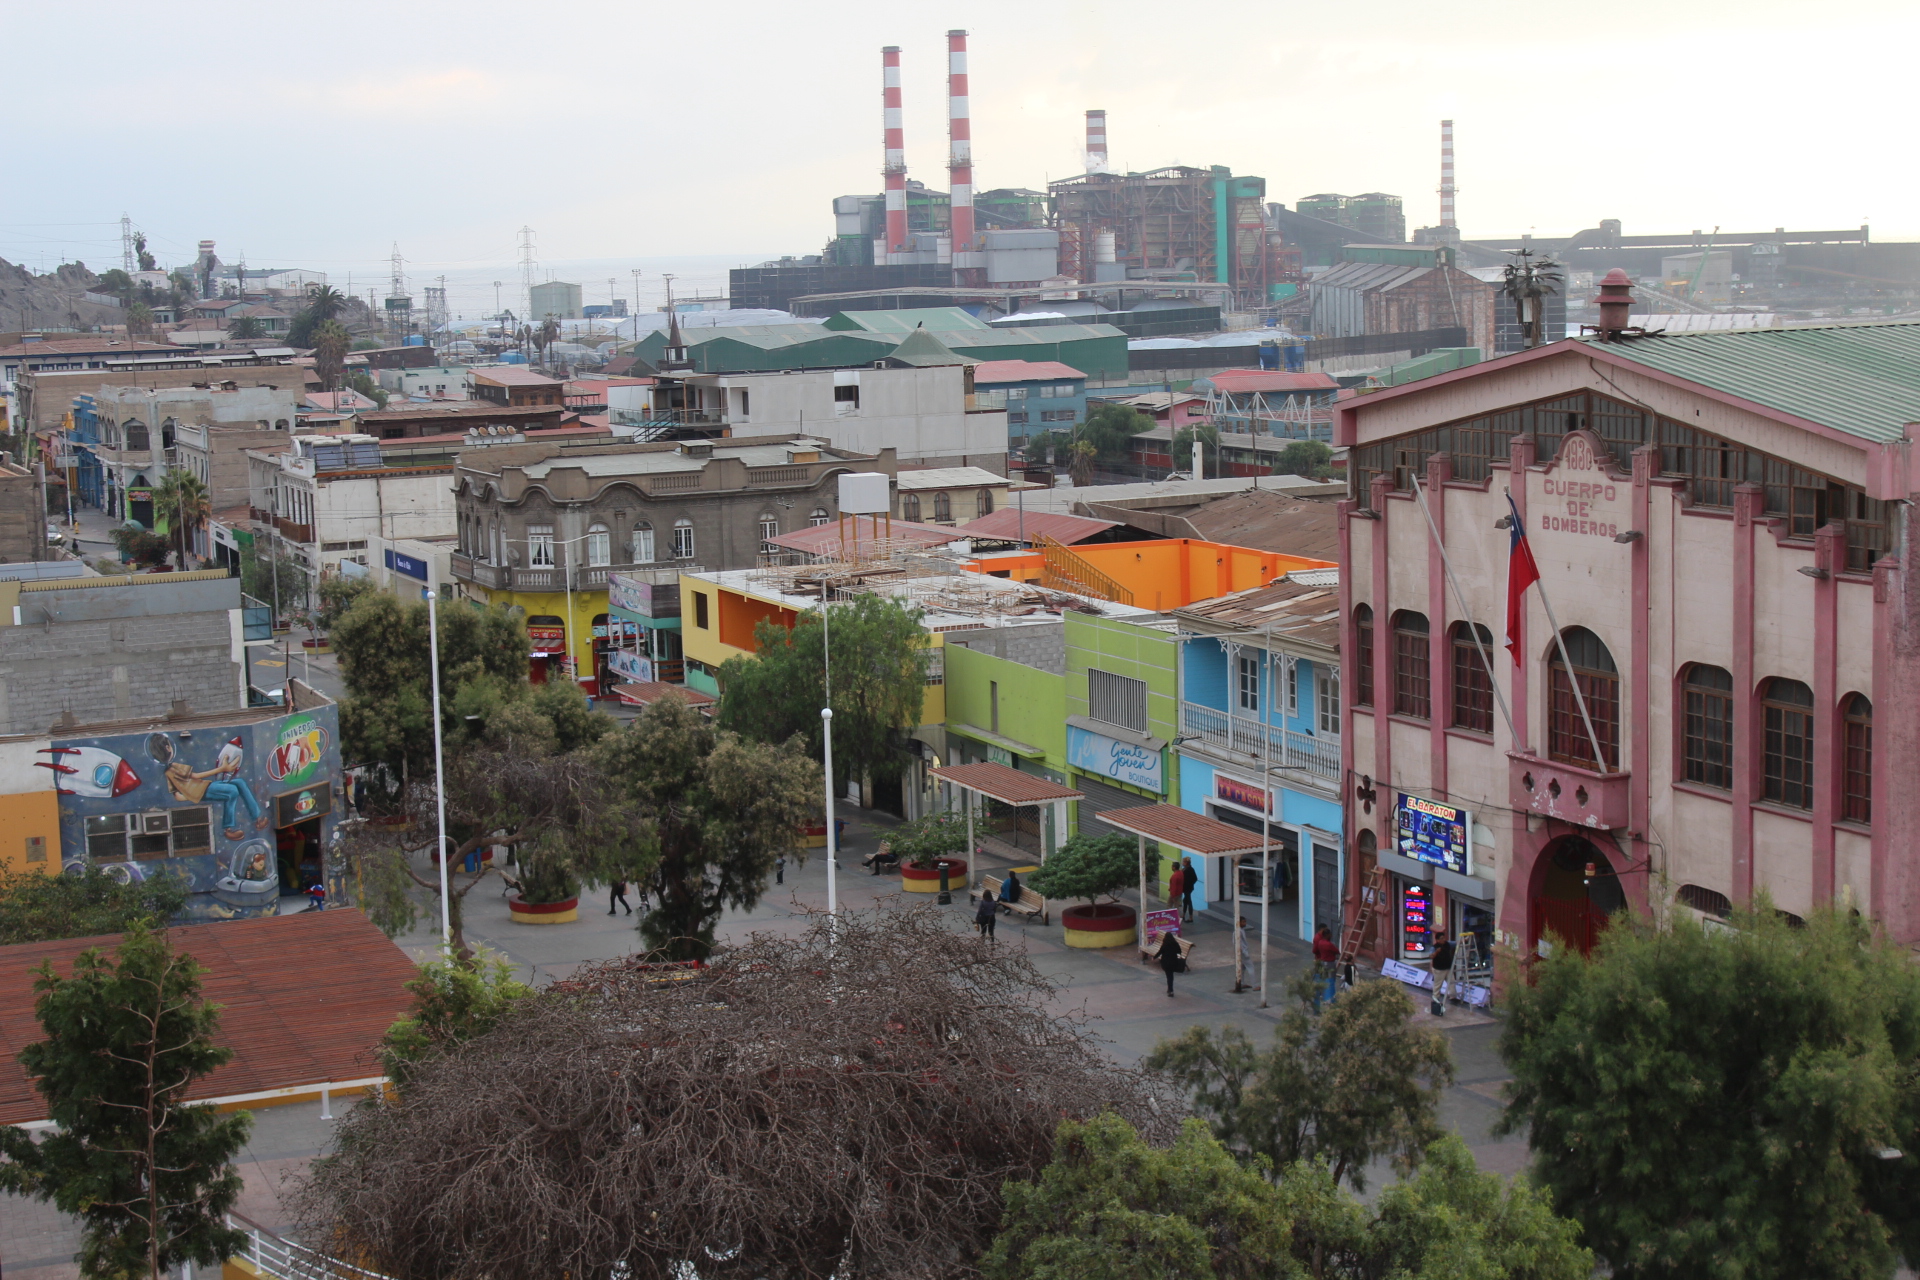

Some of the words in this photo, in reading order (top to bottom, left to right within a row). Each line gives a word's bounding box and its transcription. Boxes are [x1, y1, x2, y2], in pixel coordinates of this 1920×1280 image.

[1565, 440, 1593, 471] 1930
[1543, 479, 1616, 501] CUERPO
[1568, 501, 1589, 517] DE
[1542, 515, 1617, 538] BOMBEROS
[281, 720, 316, 742] UNIVERSO
[1110, 741, 1149, 760] Gente
[1128, 771, 1159, 788] BOUTIQUE
[1406, 797, 1417, 809] EL
[1417, 800, 1456, 820] BARATON
